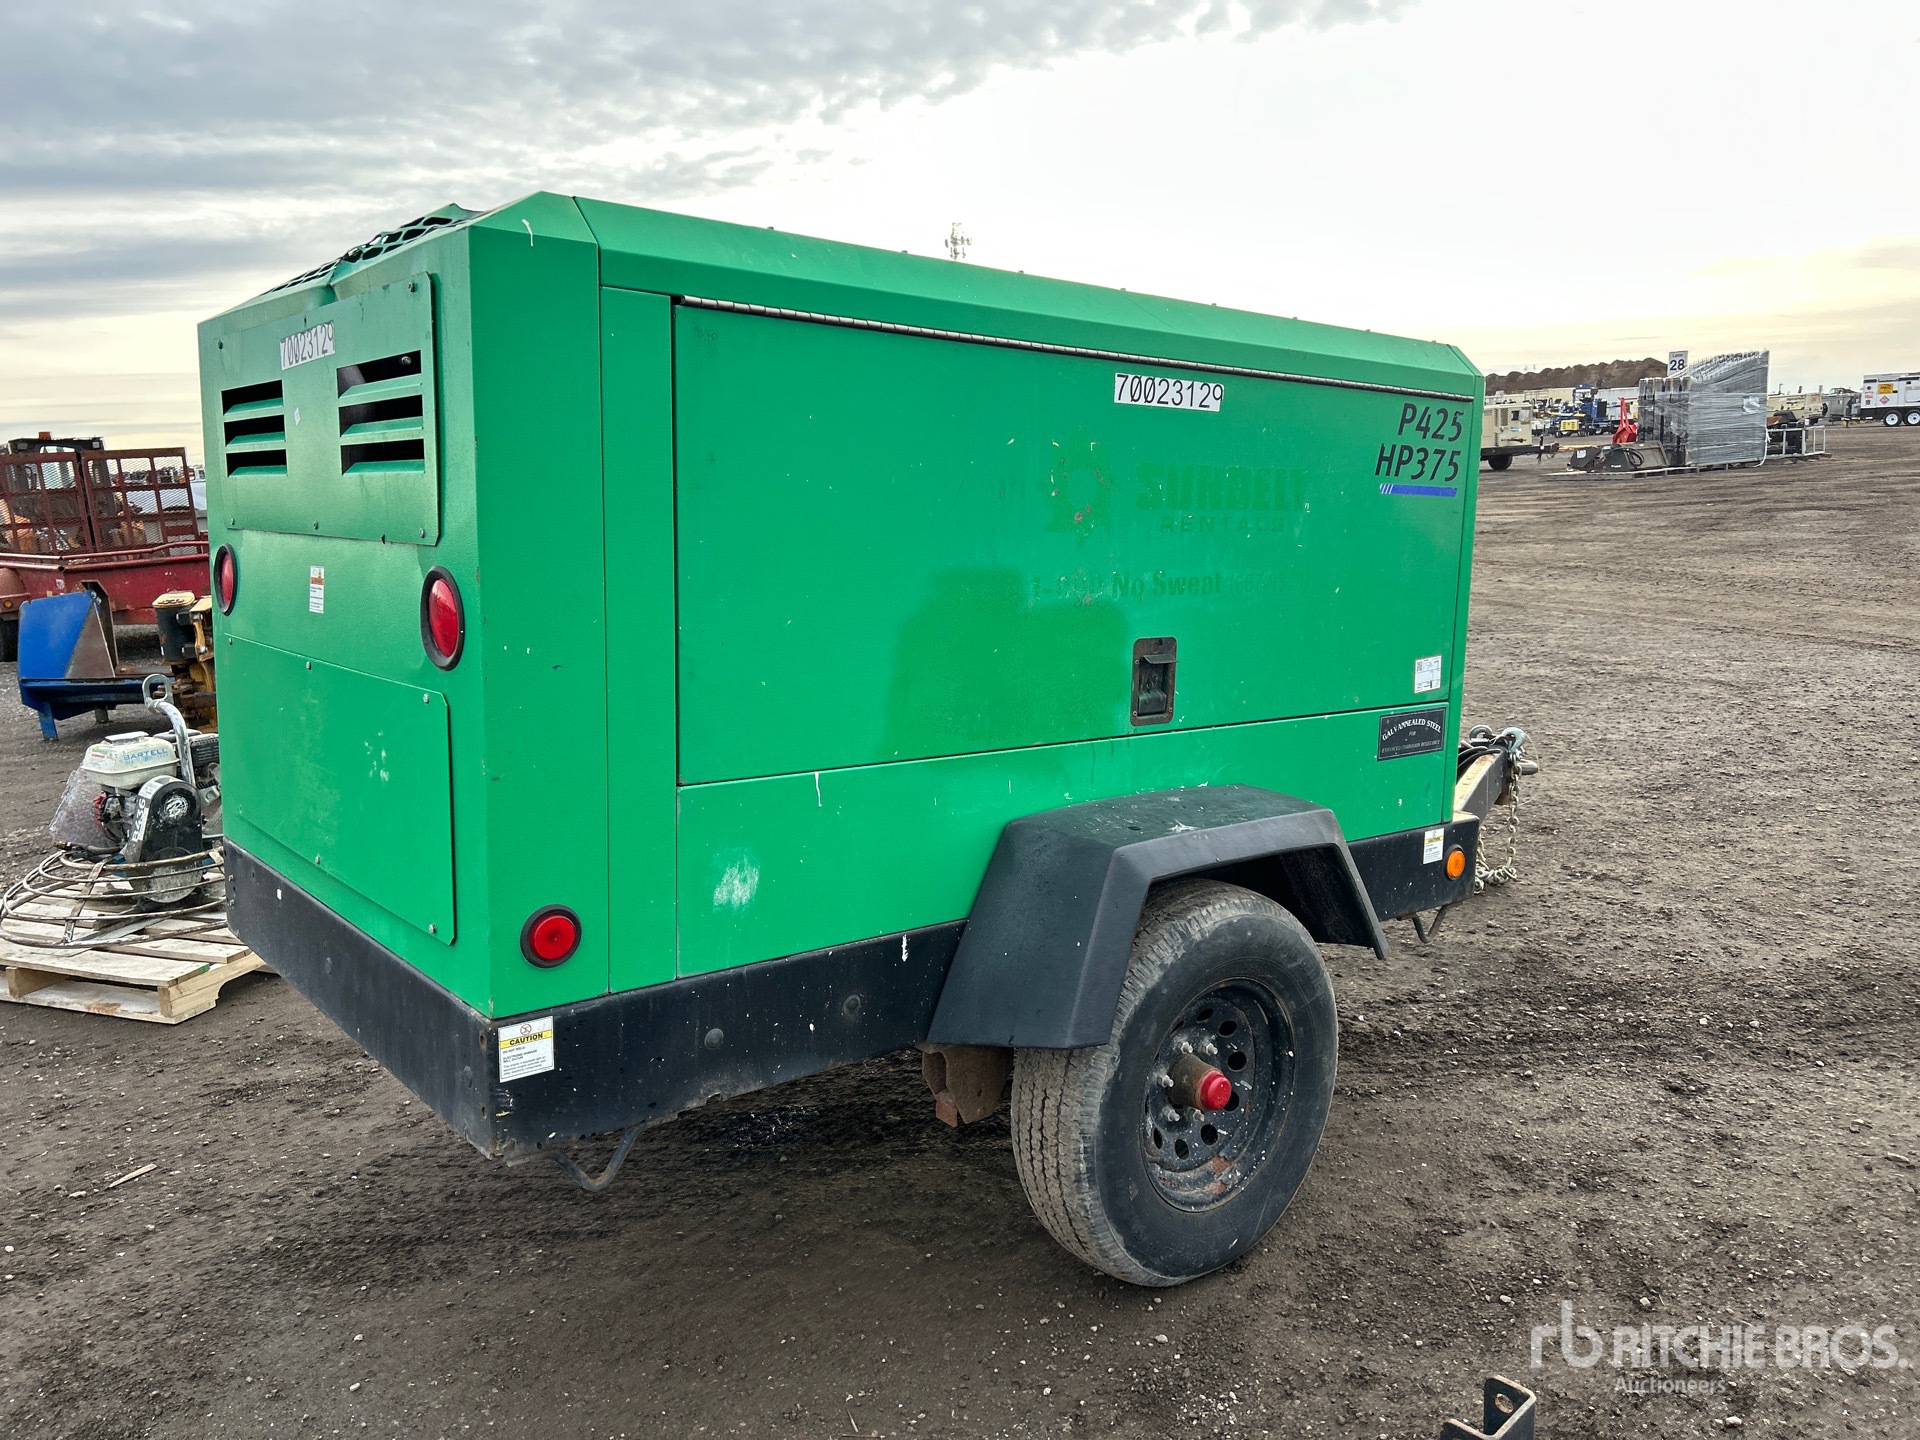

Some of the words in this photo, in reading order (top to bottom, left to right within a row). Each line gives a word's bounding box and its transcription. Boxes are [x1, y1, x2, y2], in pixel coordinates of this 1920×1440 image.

[280, 320, 334, 368] 70023129
[1670, 359, 1685, 370] 28
[1116, 373, 1223, 409] 70023129
[1397, 402, 1464, 442] P425
[1375, 443, 1461, 482] HP375
[1152, 570, 1221, 597] Sweat
[1426, 720, 1441, 733] STEEL
[124, 747, 168, 761] BARTELL
[509, 1032, 543, 1046] CAUTION
